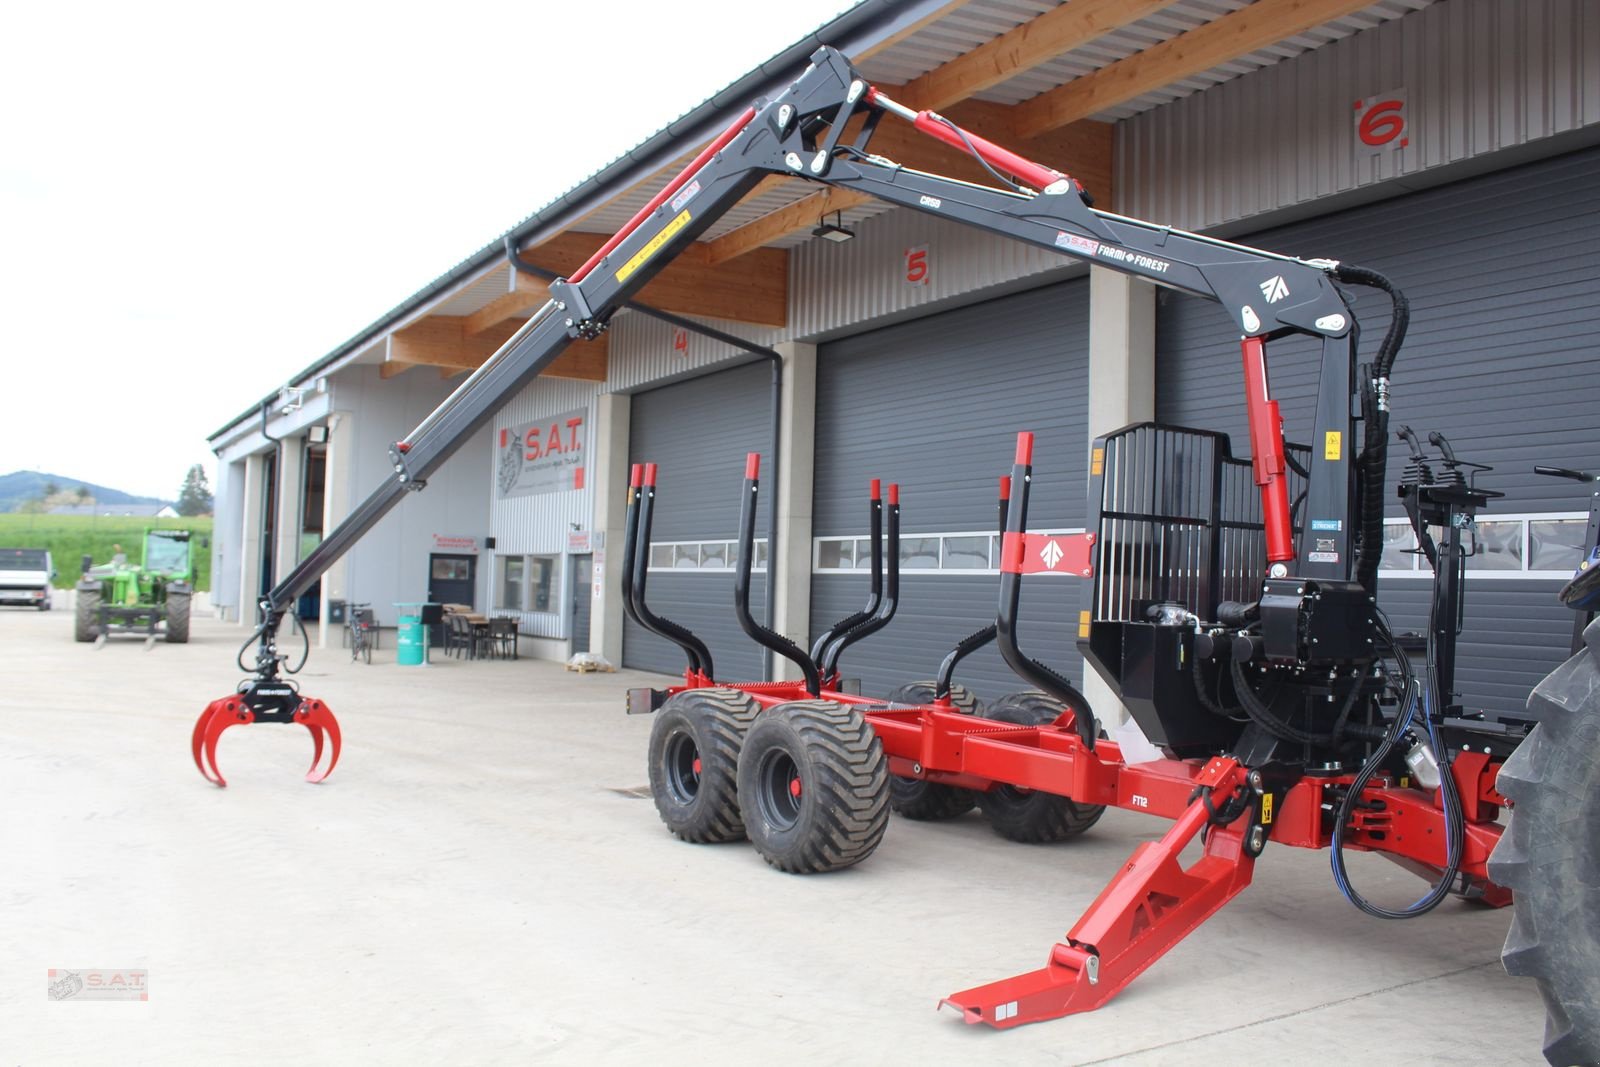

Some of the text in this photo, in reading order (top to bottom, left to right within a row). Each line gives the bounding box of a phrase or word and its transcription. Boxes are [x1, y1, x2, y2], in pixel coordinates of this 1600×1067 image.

[1359, 101, 1404, 146] 6
[908, 250, 927, 282] 5
[1098, 244, 1170, 273] FARMI FOREST
[675, 330, 687, 352] 4
[526, 417, 582, 461] S.A.T.
[1132, 794, 1148, 808] FT12
